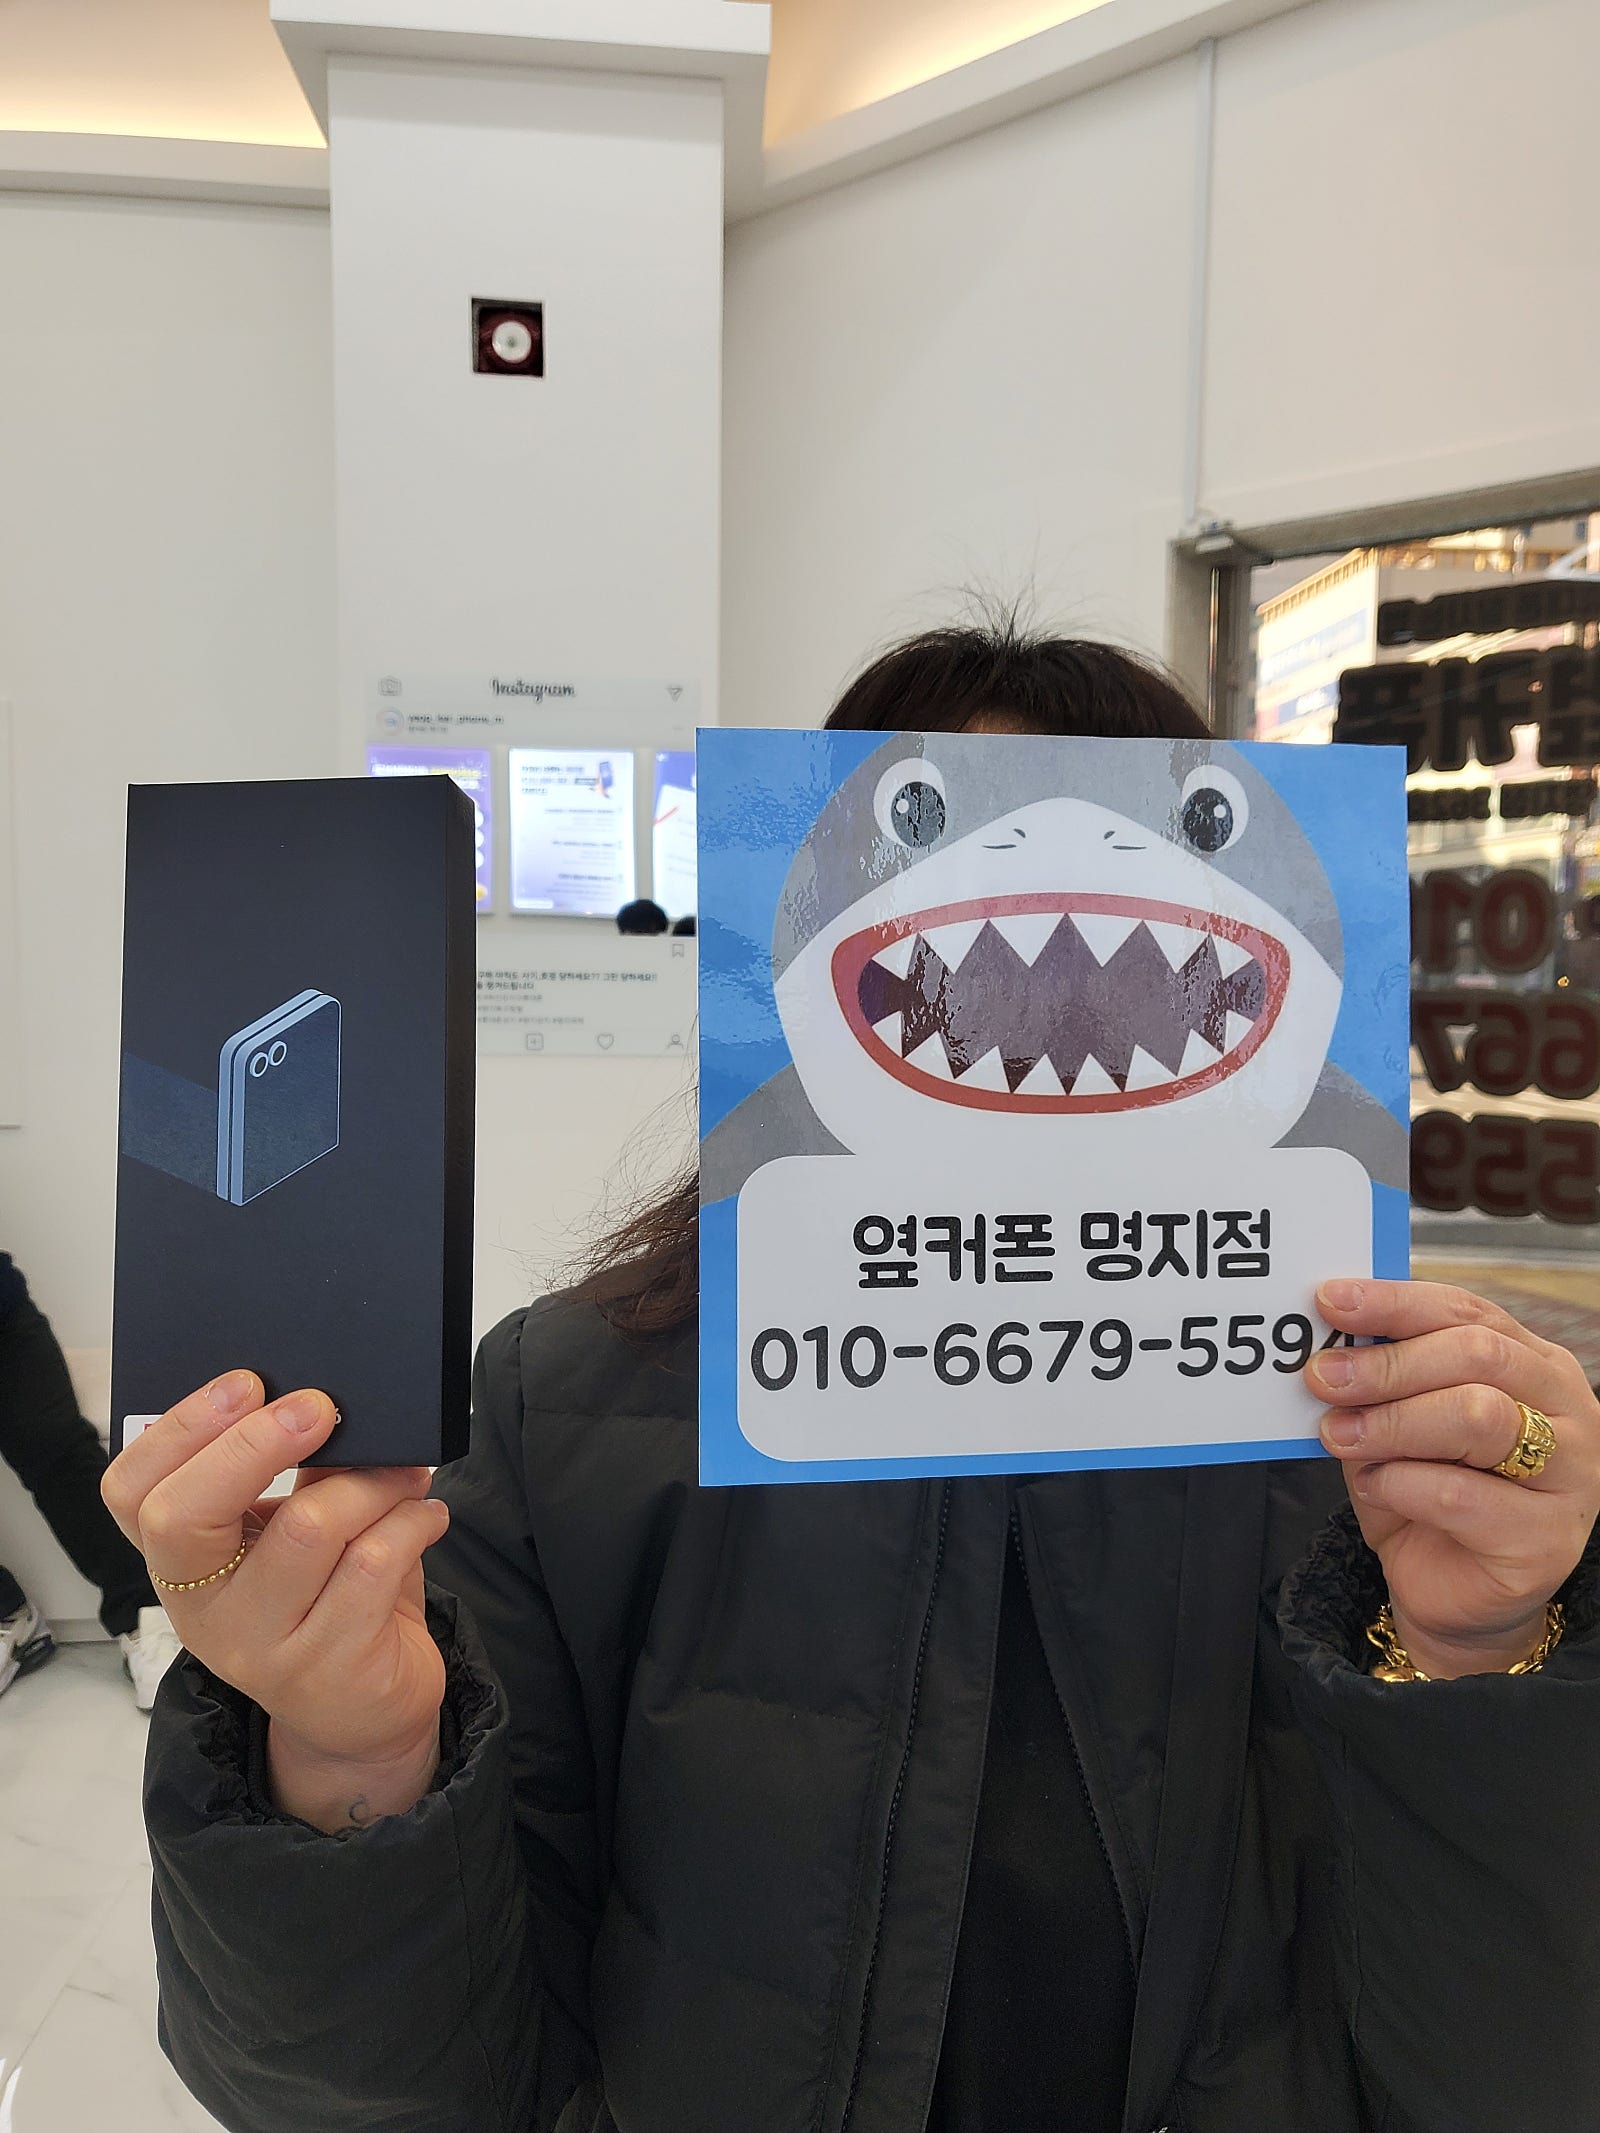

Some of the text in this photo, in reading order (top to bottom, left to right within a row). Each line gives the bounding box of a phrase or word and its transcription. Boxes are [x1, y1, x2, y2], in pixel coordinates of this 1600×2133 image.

[490, 678, 576, 703] Instagram
[852, 1208, 1272, 1289] 옆커폰 명지점
